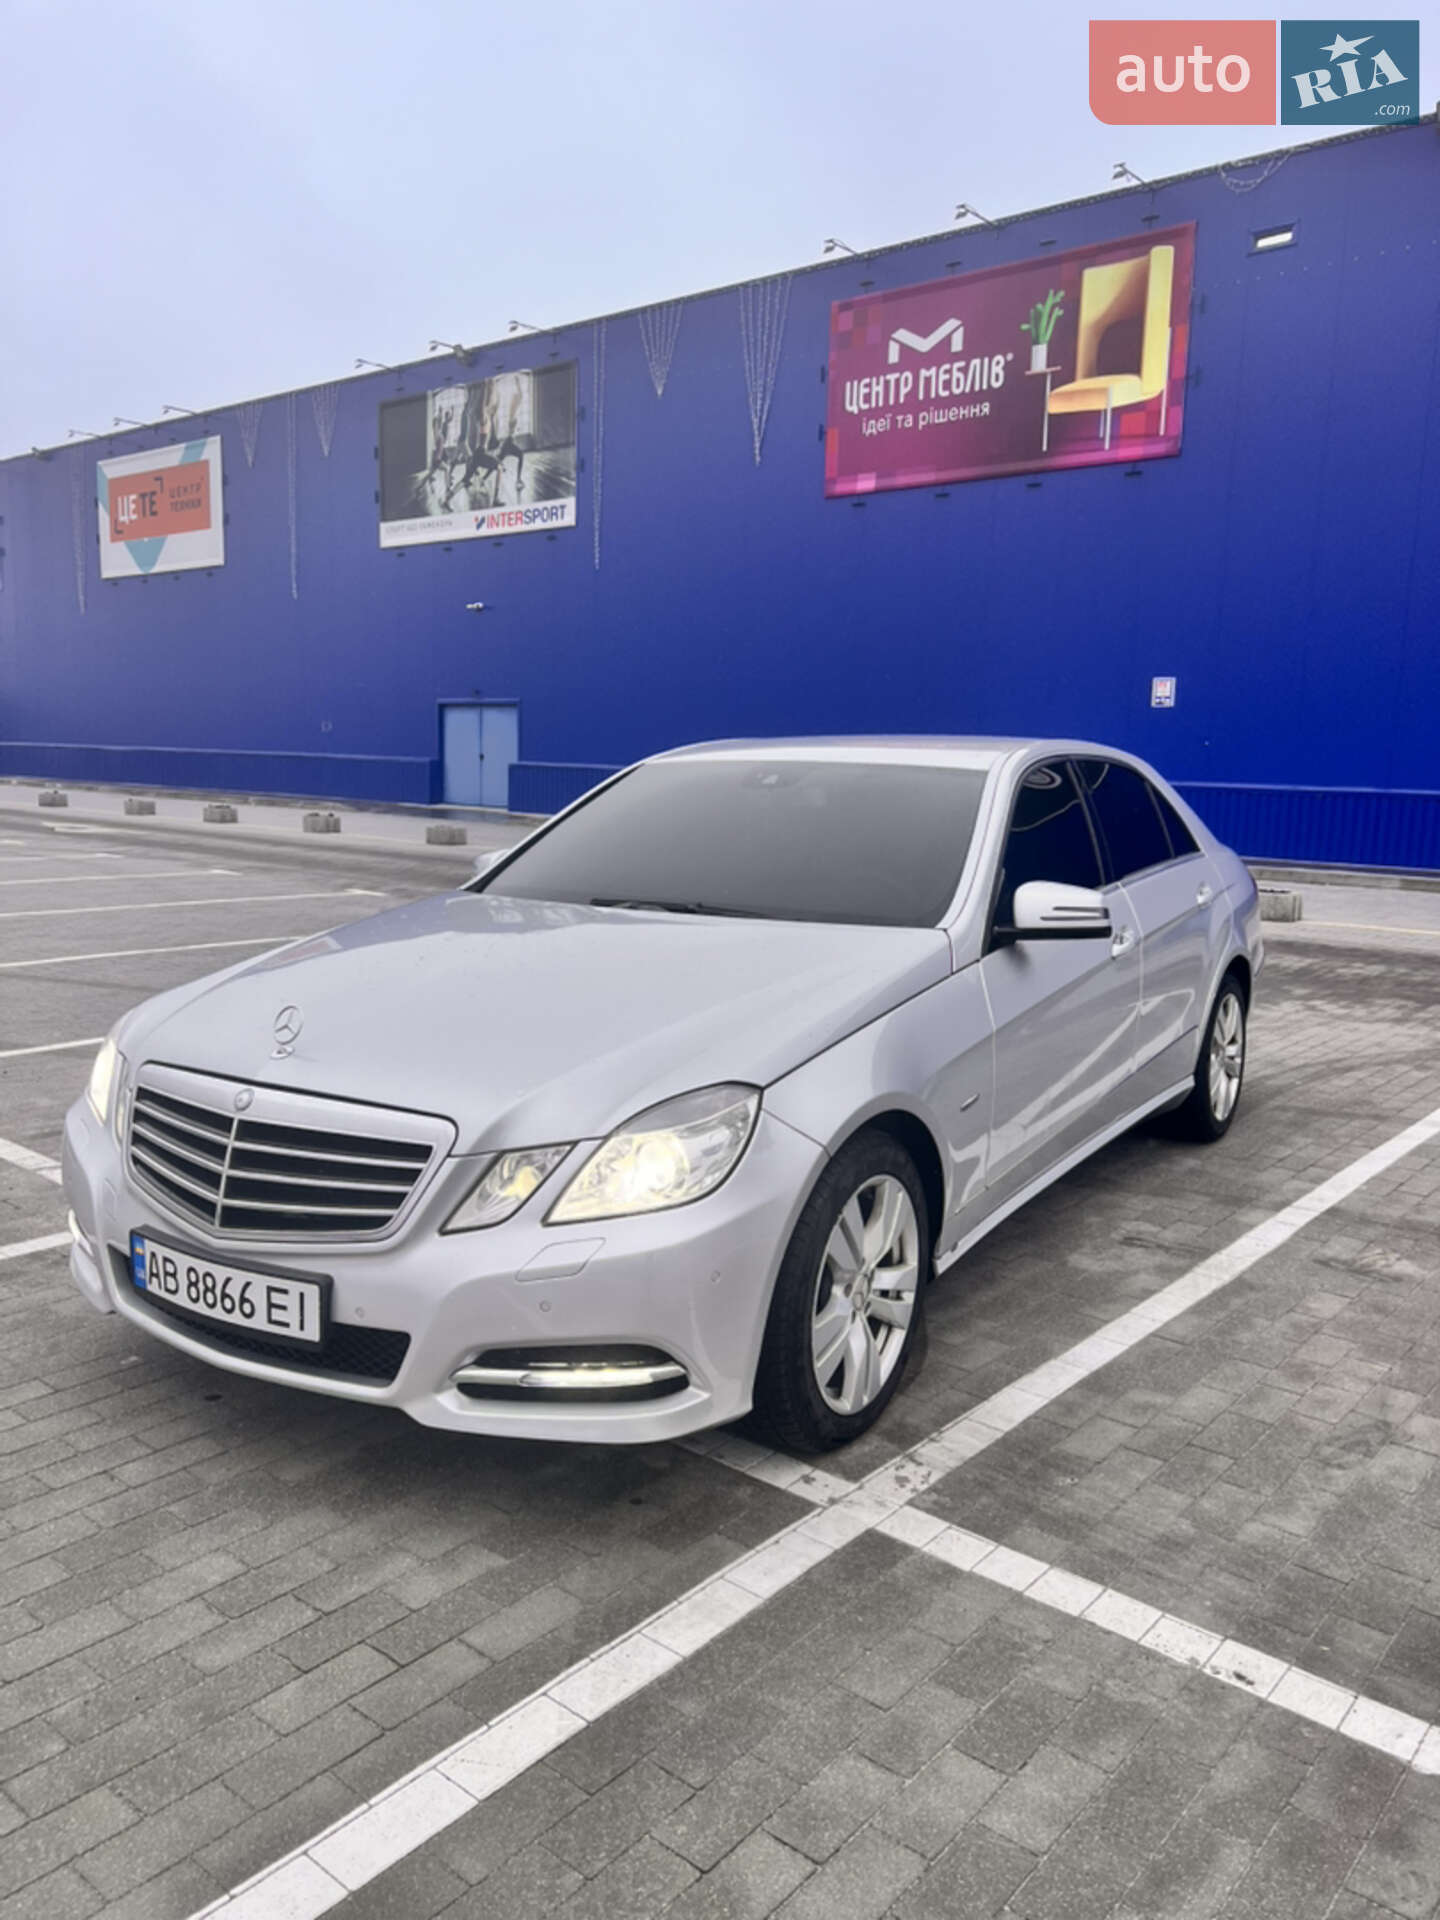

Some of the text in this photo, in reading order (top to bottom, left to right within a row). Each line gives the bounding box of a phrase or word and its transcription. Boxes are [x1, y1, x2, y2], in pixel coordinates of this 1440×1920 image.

[845, 354, 1006, 415] ЦЕНТР МЕБЛІВ
[862, 402, 991, 437] ідеї та рішення
[486, 504, 567, 529] INTERSPORT
[149, 1251, 305, 1331] AB 8866 EI
